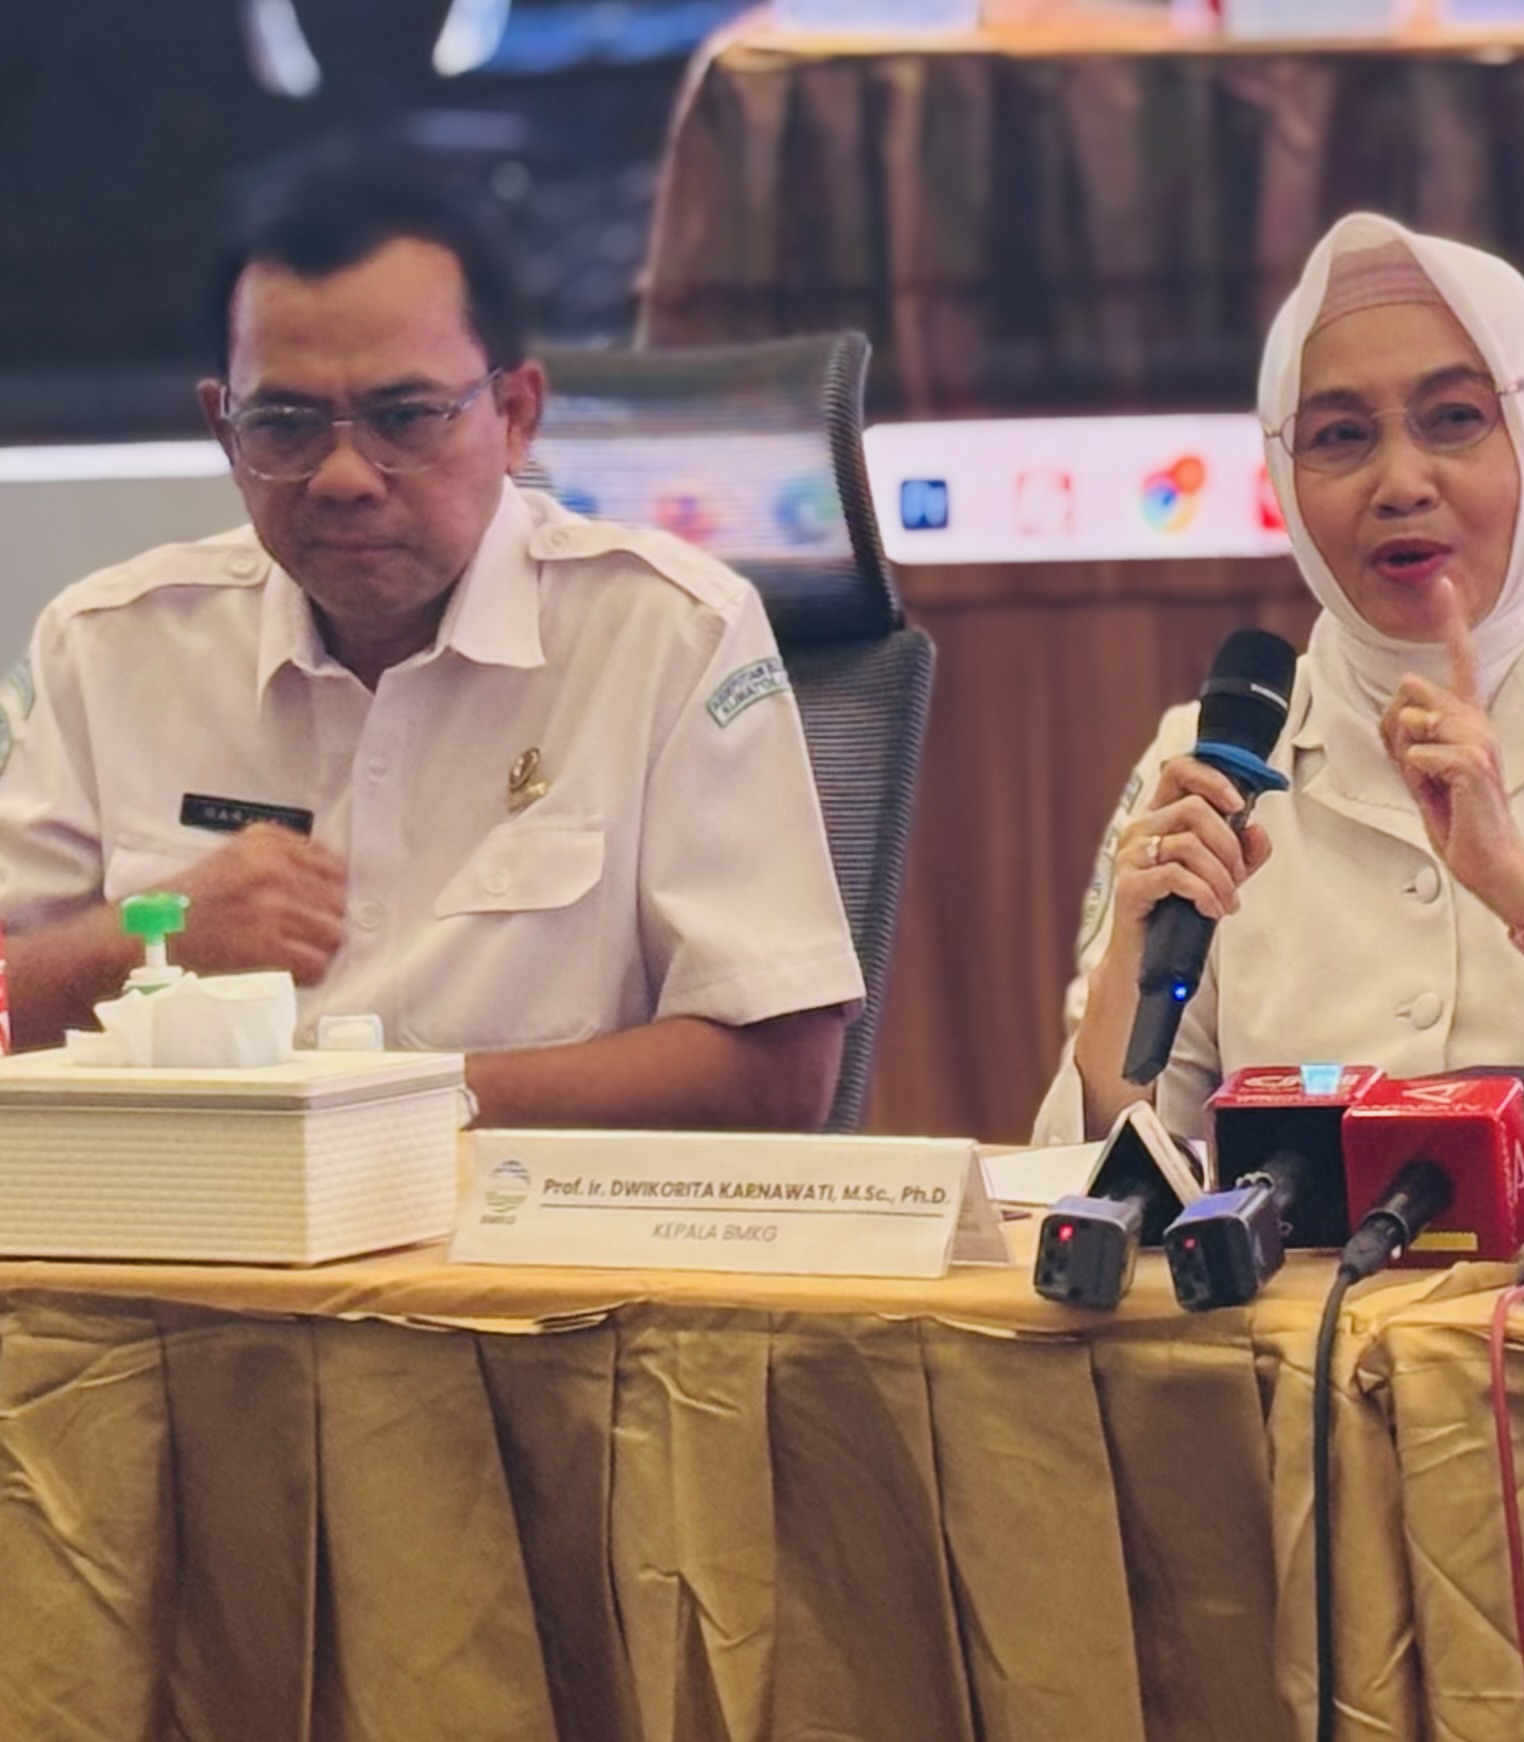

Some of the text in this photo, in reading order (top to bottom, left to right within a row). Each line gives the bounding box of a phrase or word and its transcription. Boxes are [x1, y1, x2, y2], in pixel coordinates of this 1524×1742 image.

[542, 1177, 584, 1196] Prof.
[610, 1179, 714, 1199] DWIKORITA
[718, 1181, 836, 1203] KARNAWATI,
[900, 1186, 950, 1205] Ph.D.
[652, 1222, 778, 1243] KEPALA BMKG
